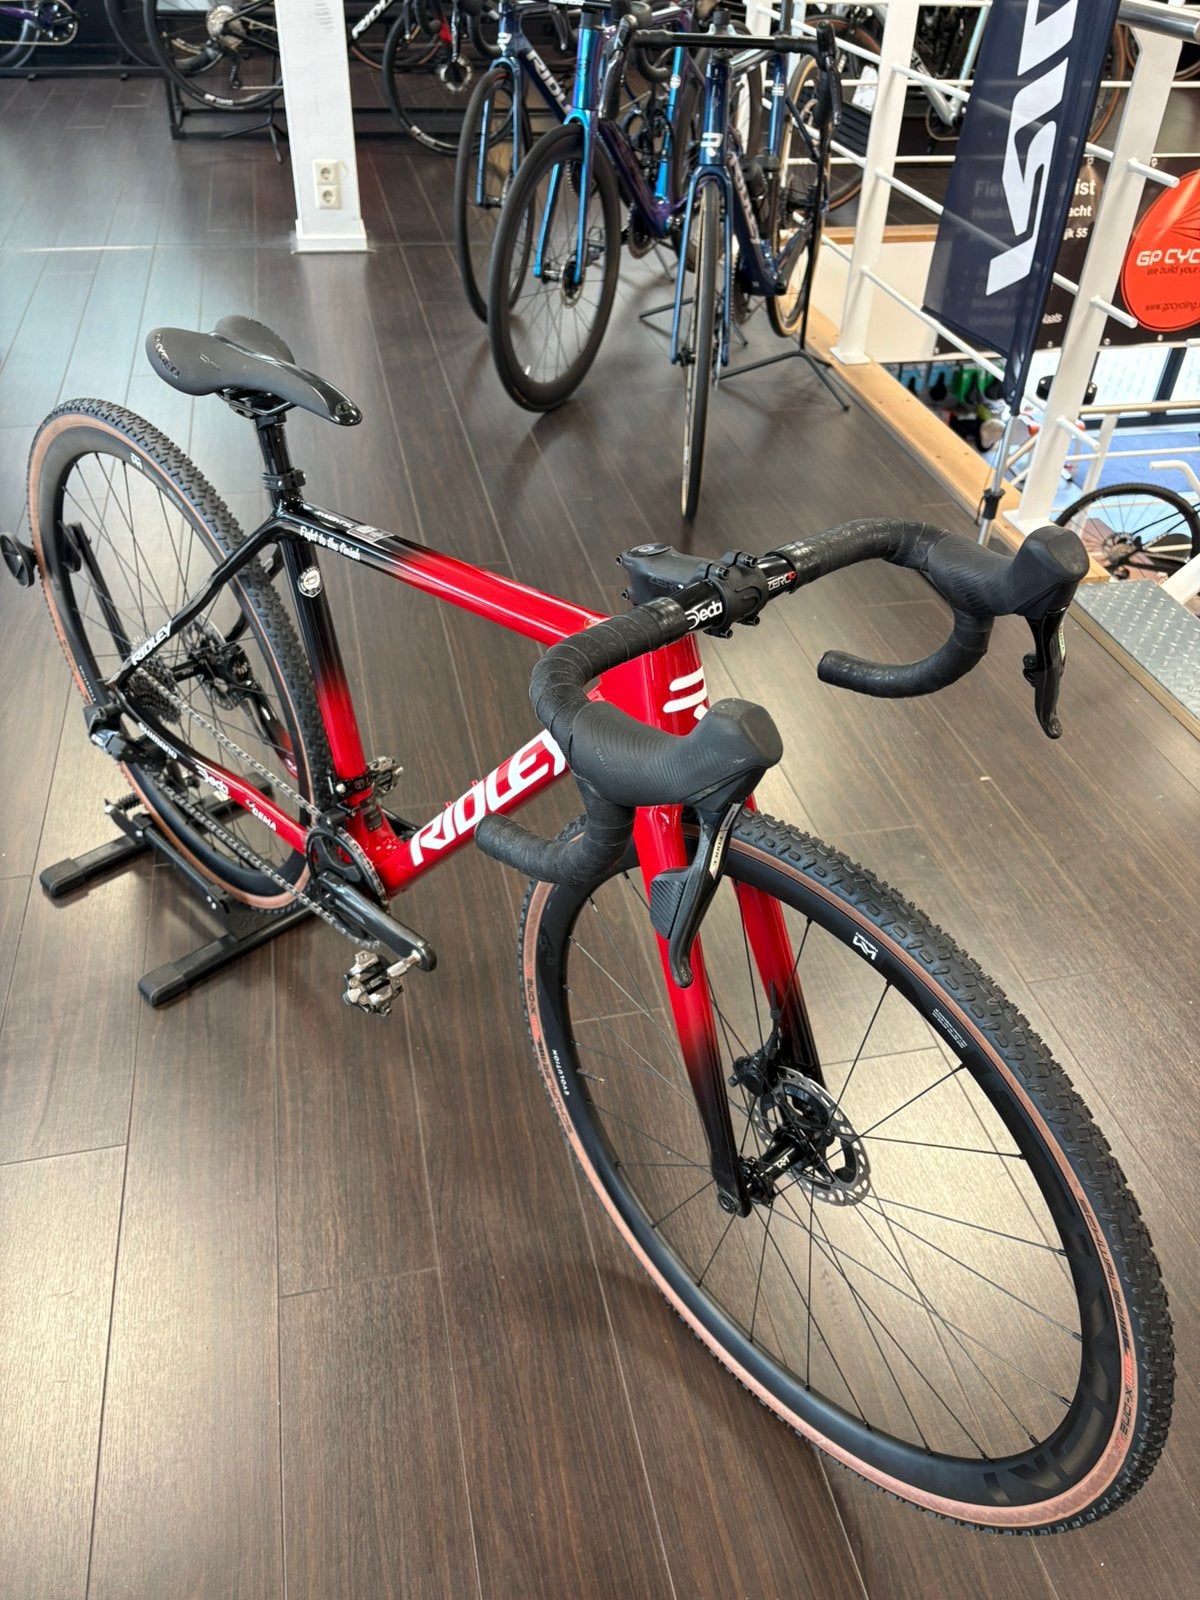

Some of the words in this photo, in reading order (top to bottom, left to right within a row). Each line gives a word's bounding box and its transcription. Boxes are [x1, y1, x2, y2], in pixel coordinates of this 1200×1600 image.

[1074, 178, 1096, 196] ist
[1136, 249, 1163, 267] GP
[300, 525, 319, 542] Fight
[318, 533, 327, 547] to
[327, 536, 340, 552] the
[339, 542, 361, 561] finish
[685, 600, 723, 630] Deda
[131, 619, 173, 666] RIDLEY
[195, 764, 229, 795] Deda
[551, 1048, 570, 1096] EVOLUTION
